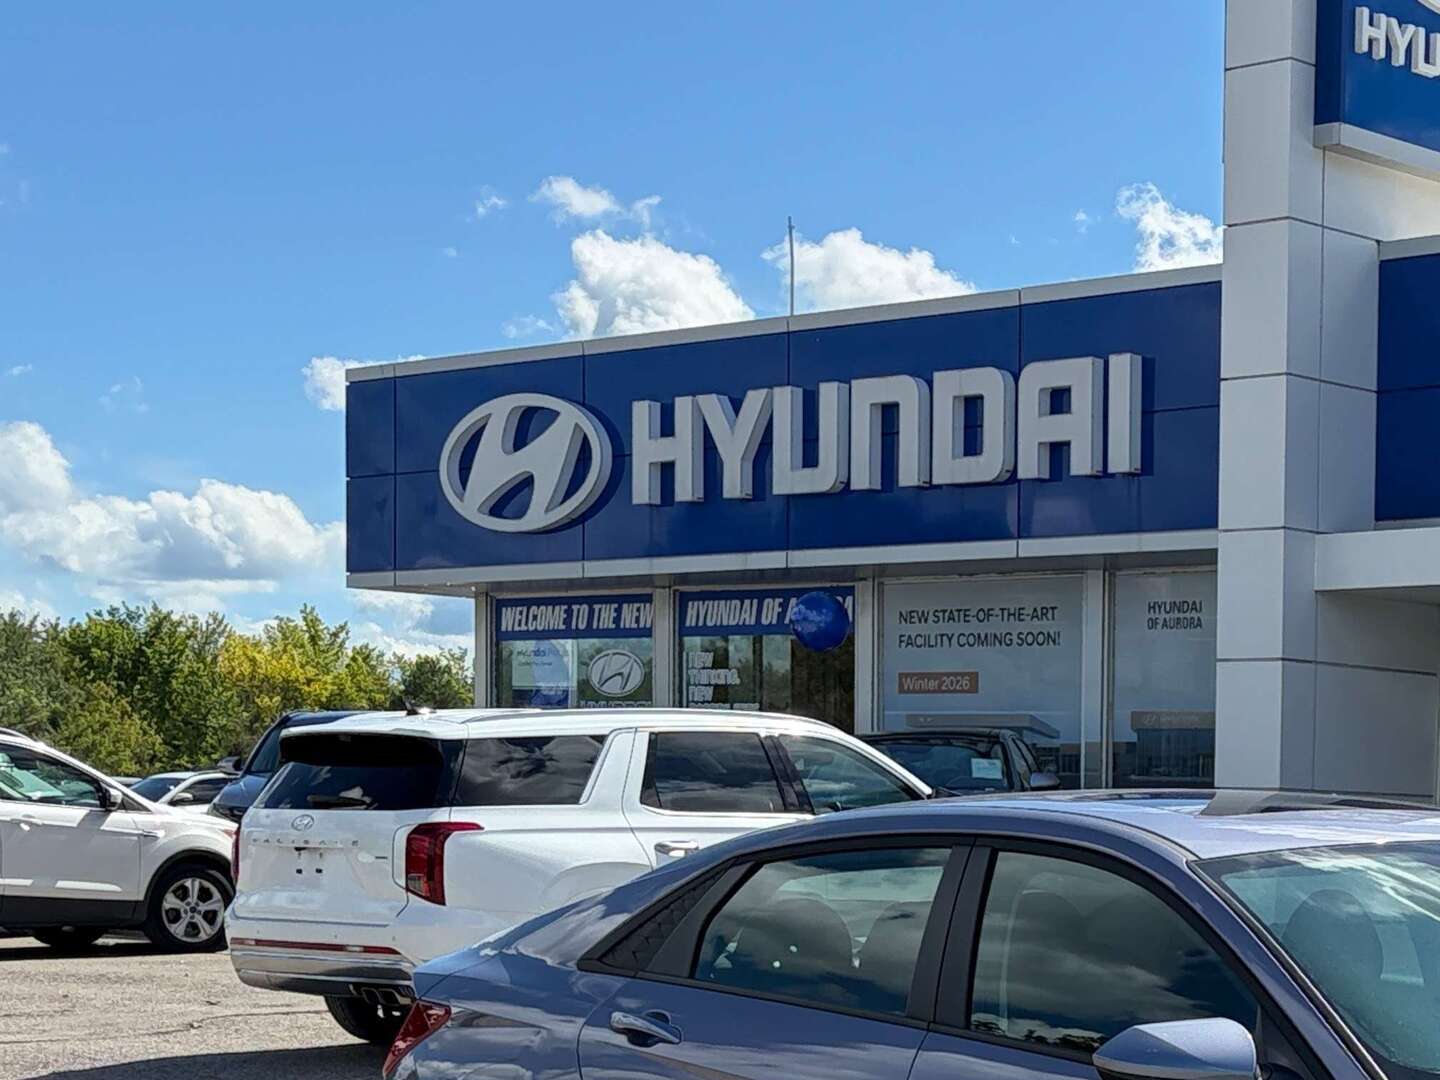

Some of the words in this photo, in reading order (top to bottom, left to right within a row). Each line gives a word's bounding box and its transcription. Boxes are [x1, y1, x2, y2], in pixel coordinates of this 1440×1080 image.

[631, 352, 1143, 506] HYUNDAI
[685, 599, 758, 627] HYUNDAI
[761, 598, 783, 626] OF
[898, 609, 930, 625] NEW
[932, 606, 1058, 624] STATE-OF-THE-ART
[1147, 600, 1203, 614] HYUNDAI
[501, 605, 568, 632] WELCOME
[572, 604, 589, 630] TO
[592, 603, 618, 629] THE
[620, 602, 654, 629] NEW
[1147, 617, 1160, 630] OF
[1161, 616, 1203, 630] AURORA
[898, 633, 954, 649] FACILITY
[956, 632, 1013, 648] COMING
[1016, 631, 1061, 647] SOON!
[903, 676, 939, 691] Winter
[941, 676, 971, 691] 2026
